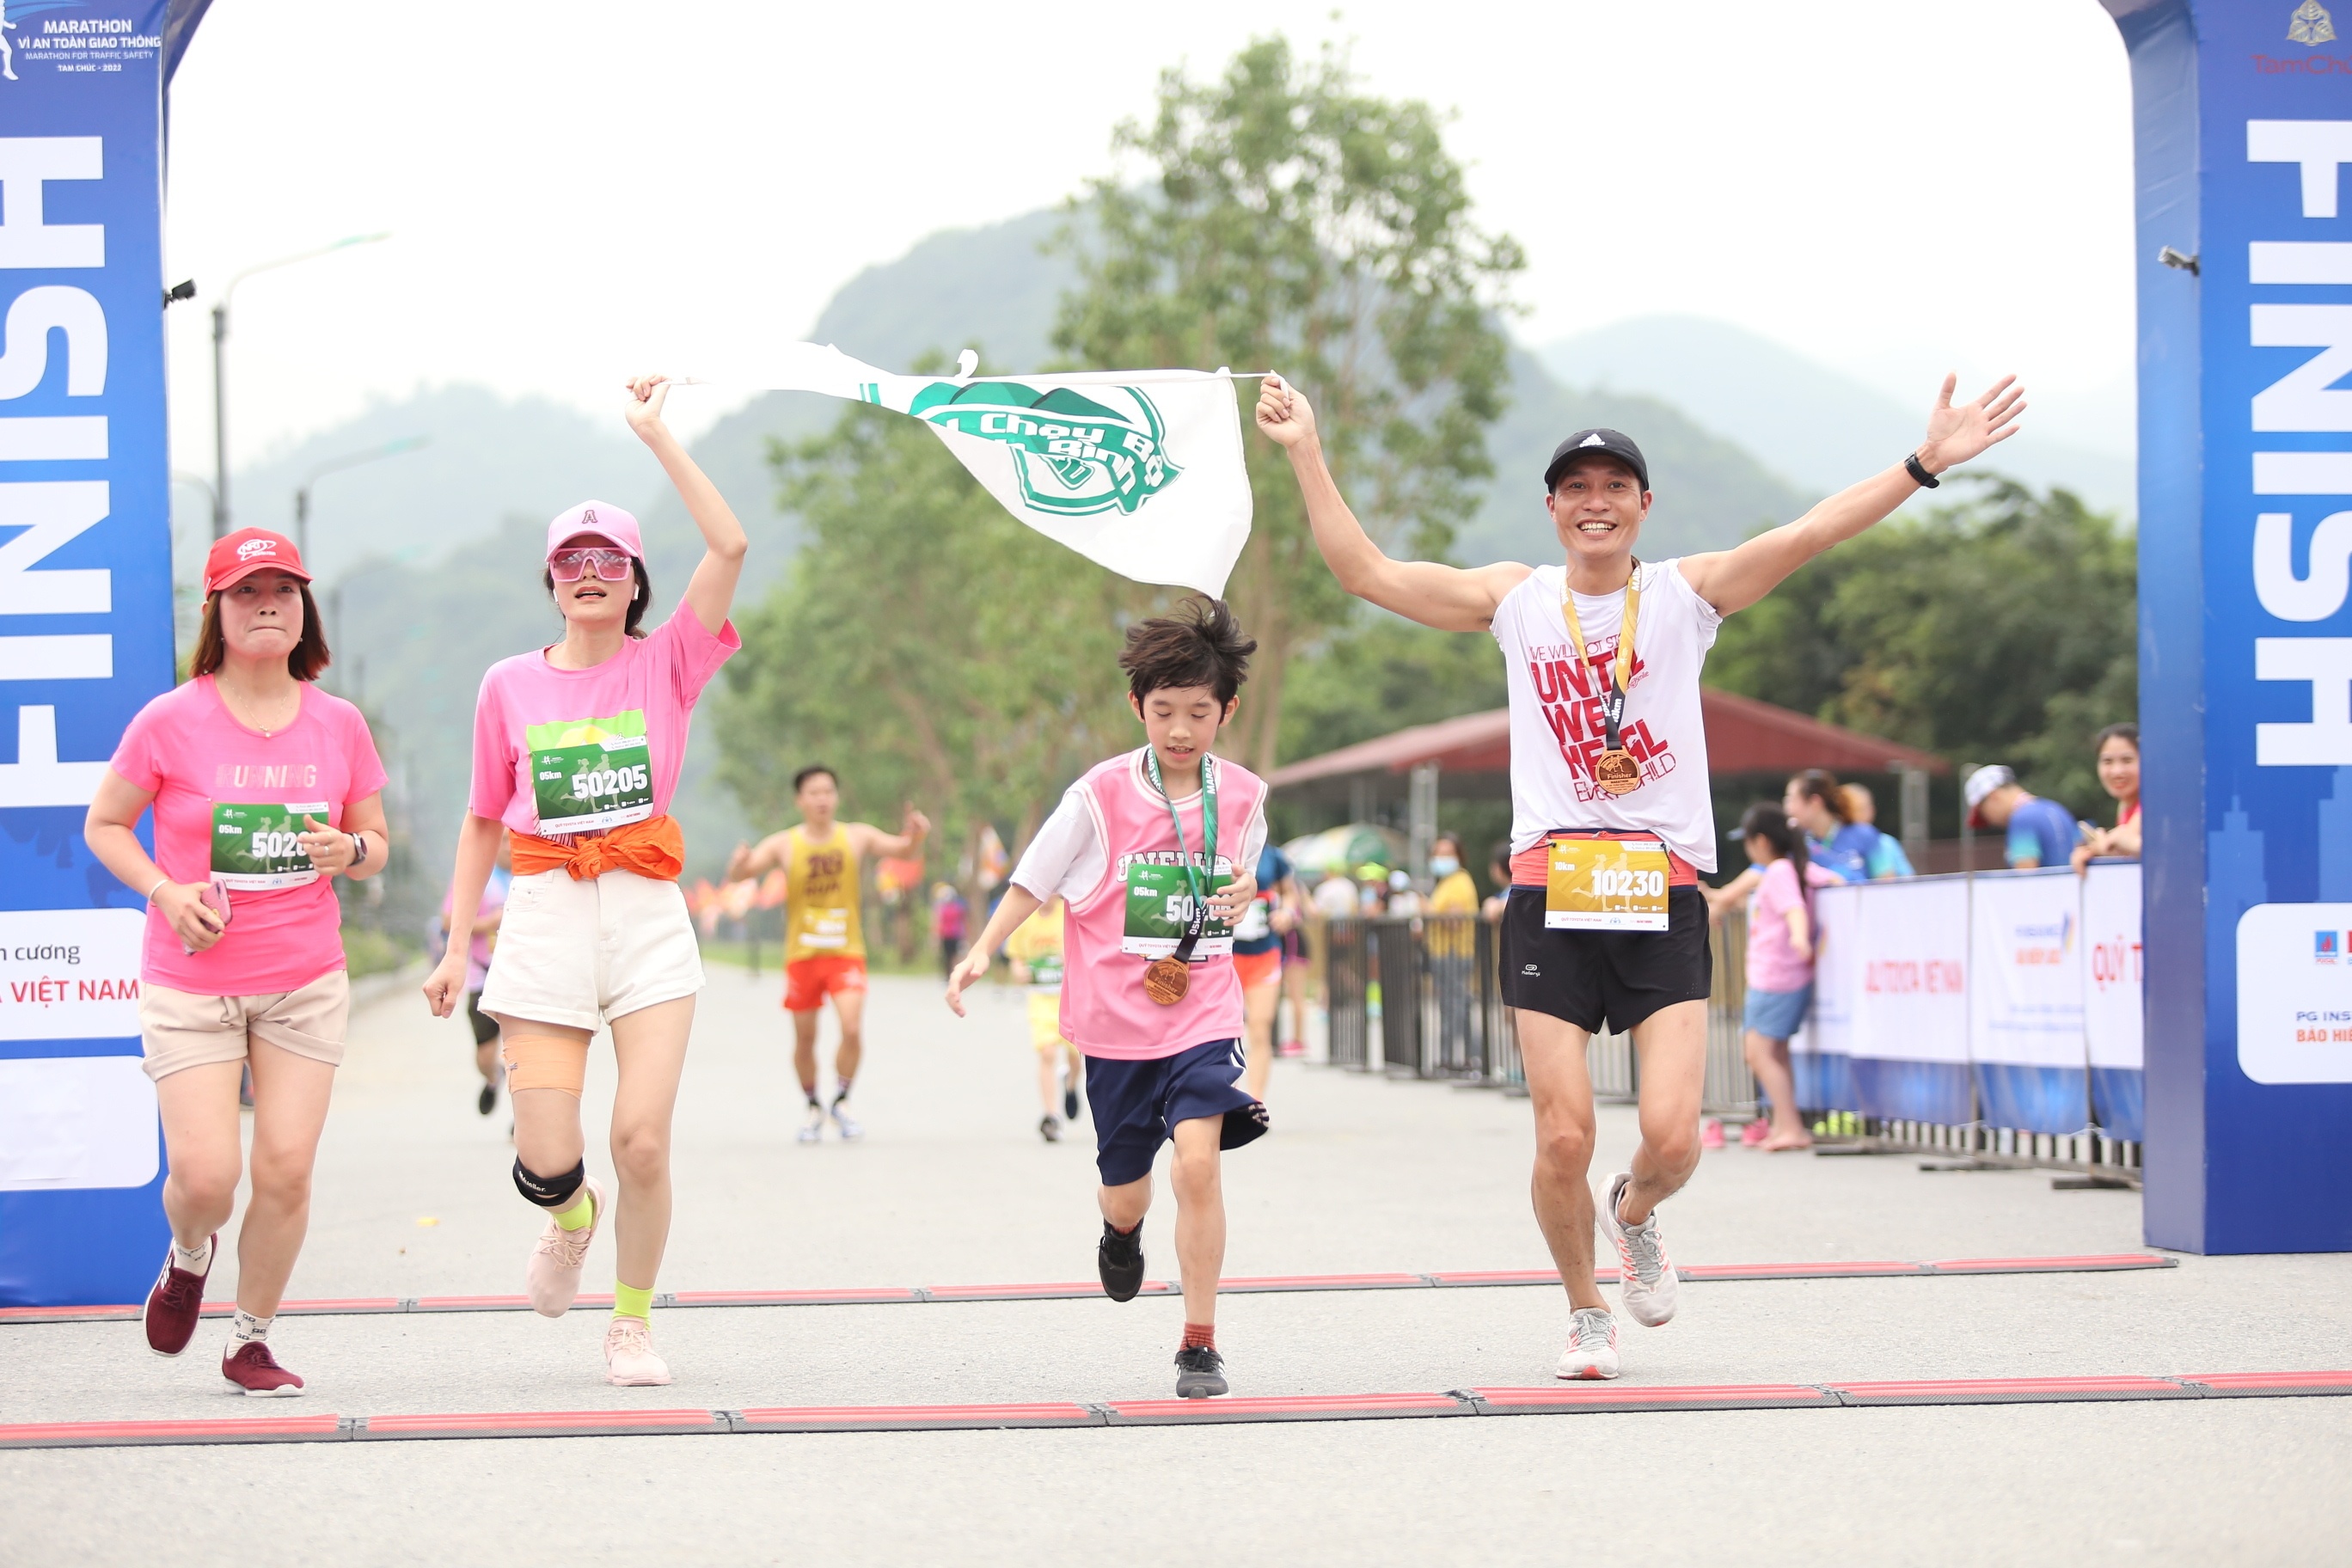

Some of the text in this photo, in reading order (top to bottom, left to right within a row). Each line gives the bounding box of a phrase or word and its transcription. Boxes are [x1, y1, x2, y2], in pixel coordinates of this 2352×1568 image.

[44, 19, 132, 34] MARATHON
[18, 34, 162, 49] VÌ AN TOÀN GIAO THÔNG
[123, 51, 154, 59] SAFETY
[582, 510, 597, 524] A
[1583, 640, 1602, 654] OT
[1530, 646, 1645, 703] UNTL
[217, 763, 317, 788] RUNNING
[540, 770, 562, 781] 05km
[572, 763, 648, 799] 50205
[218, 824, 242, 835] 05km
[1554, 861, 1576, 871] 10km
[1590, 869, 1664, 897] 10230
[1133, 886, 1158, 897] 05km
[1189, 908, 1201, 935] 05km
[15, 944, 81, 965] cương
[10, 975, 140, 1008] VIỆT NAM
